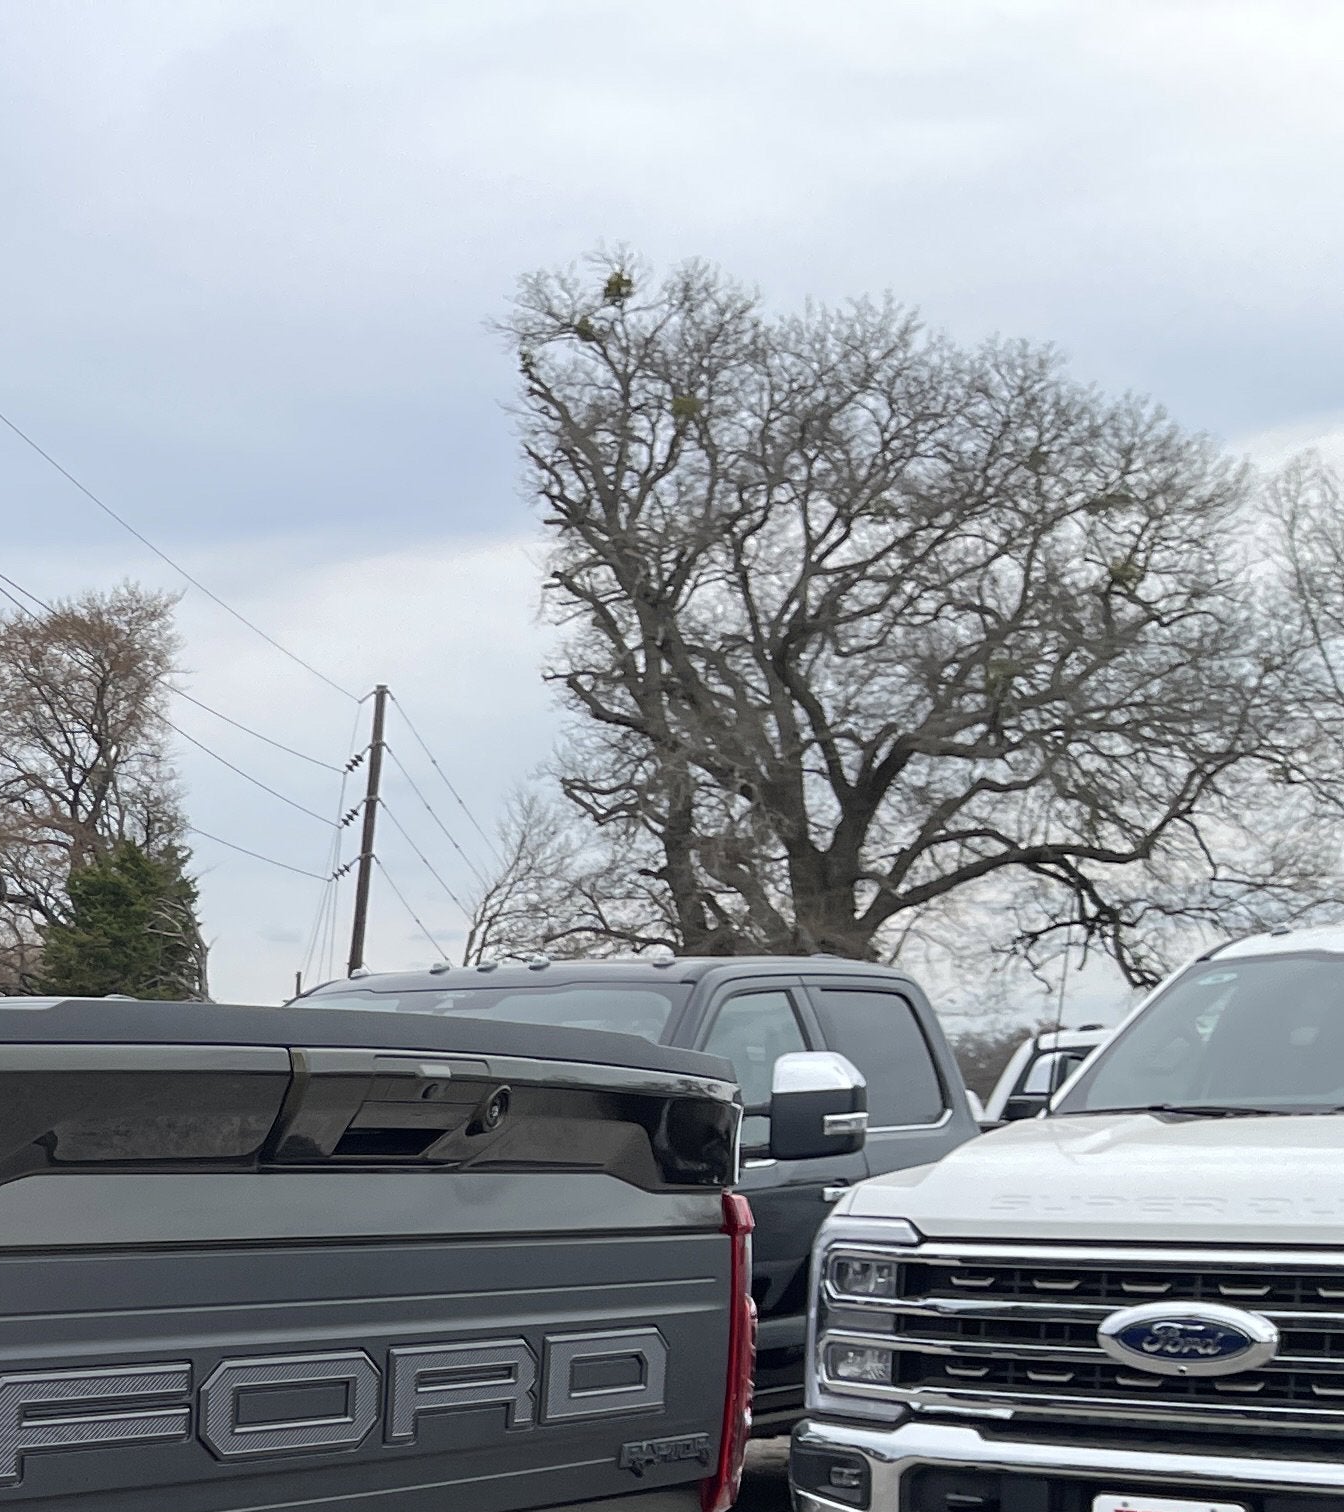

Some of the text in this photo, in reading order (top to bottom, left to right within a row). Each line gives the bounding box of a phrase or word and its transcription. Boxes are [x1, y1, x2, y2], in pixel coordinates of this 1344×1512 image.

[988, 1193, 1344, 1216] SUPER DU
[1142, 1321, 1224, 1355] Ford
